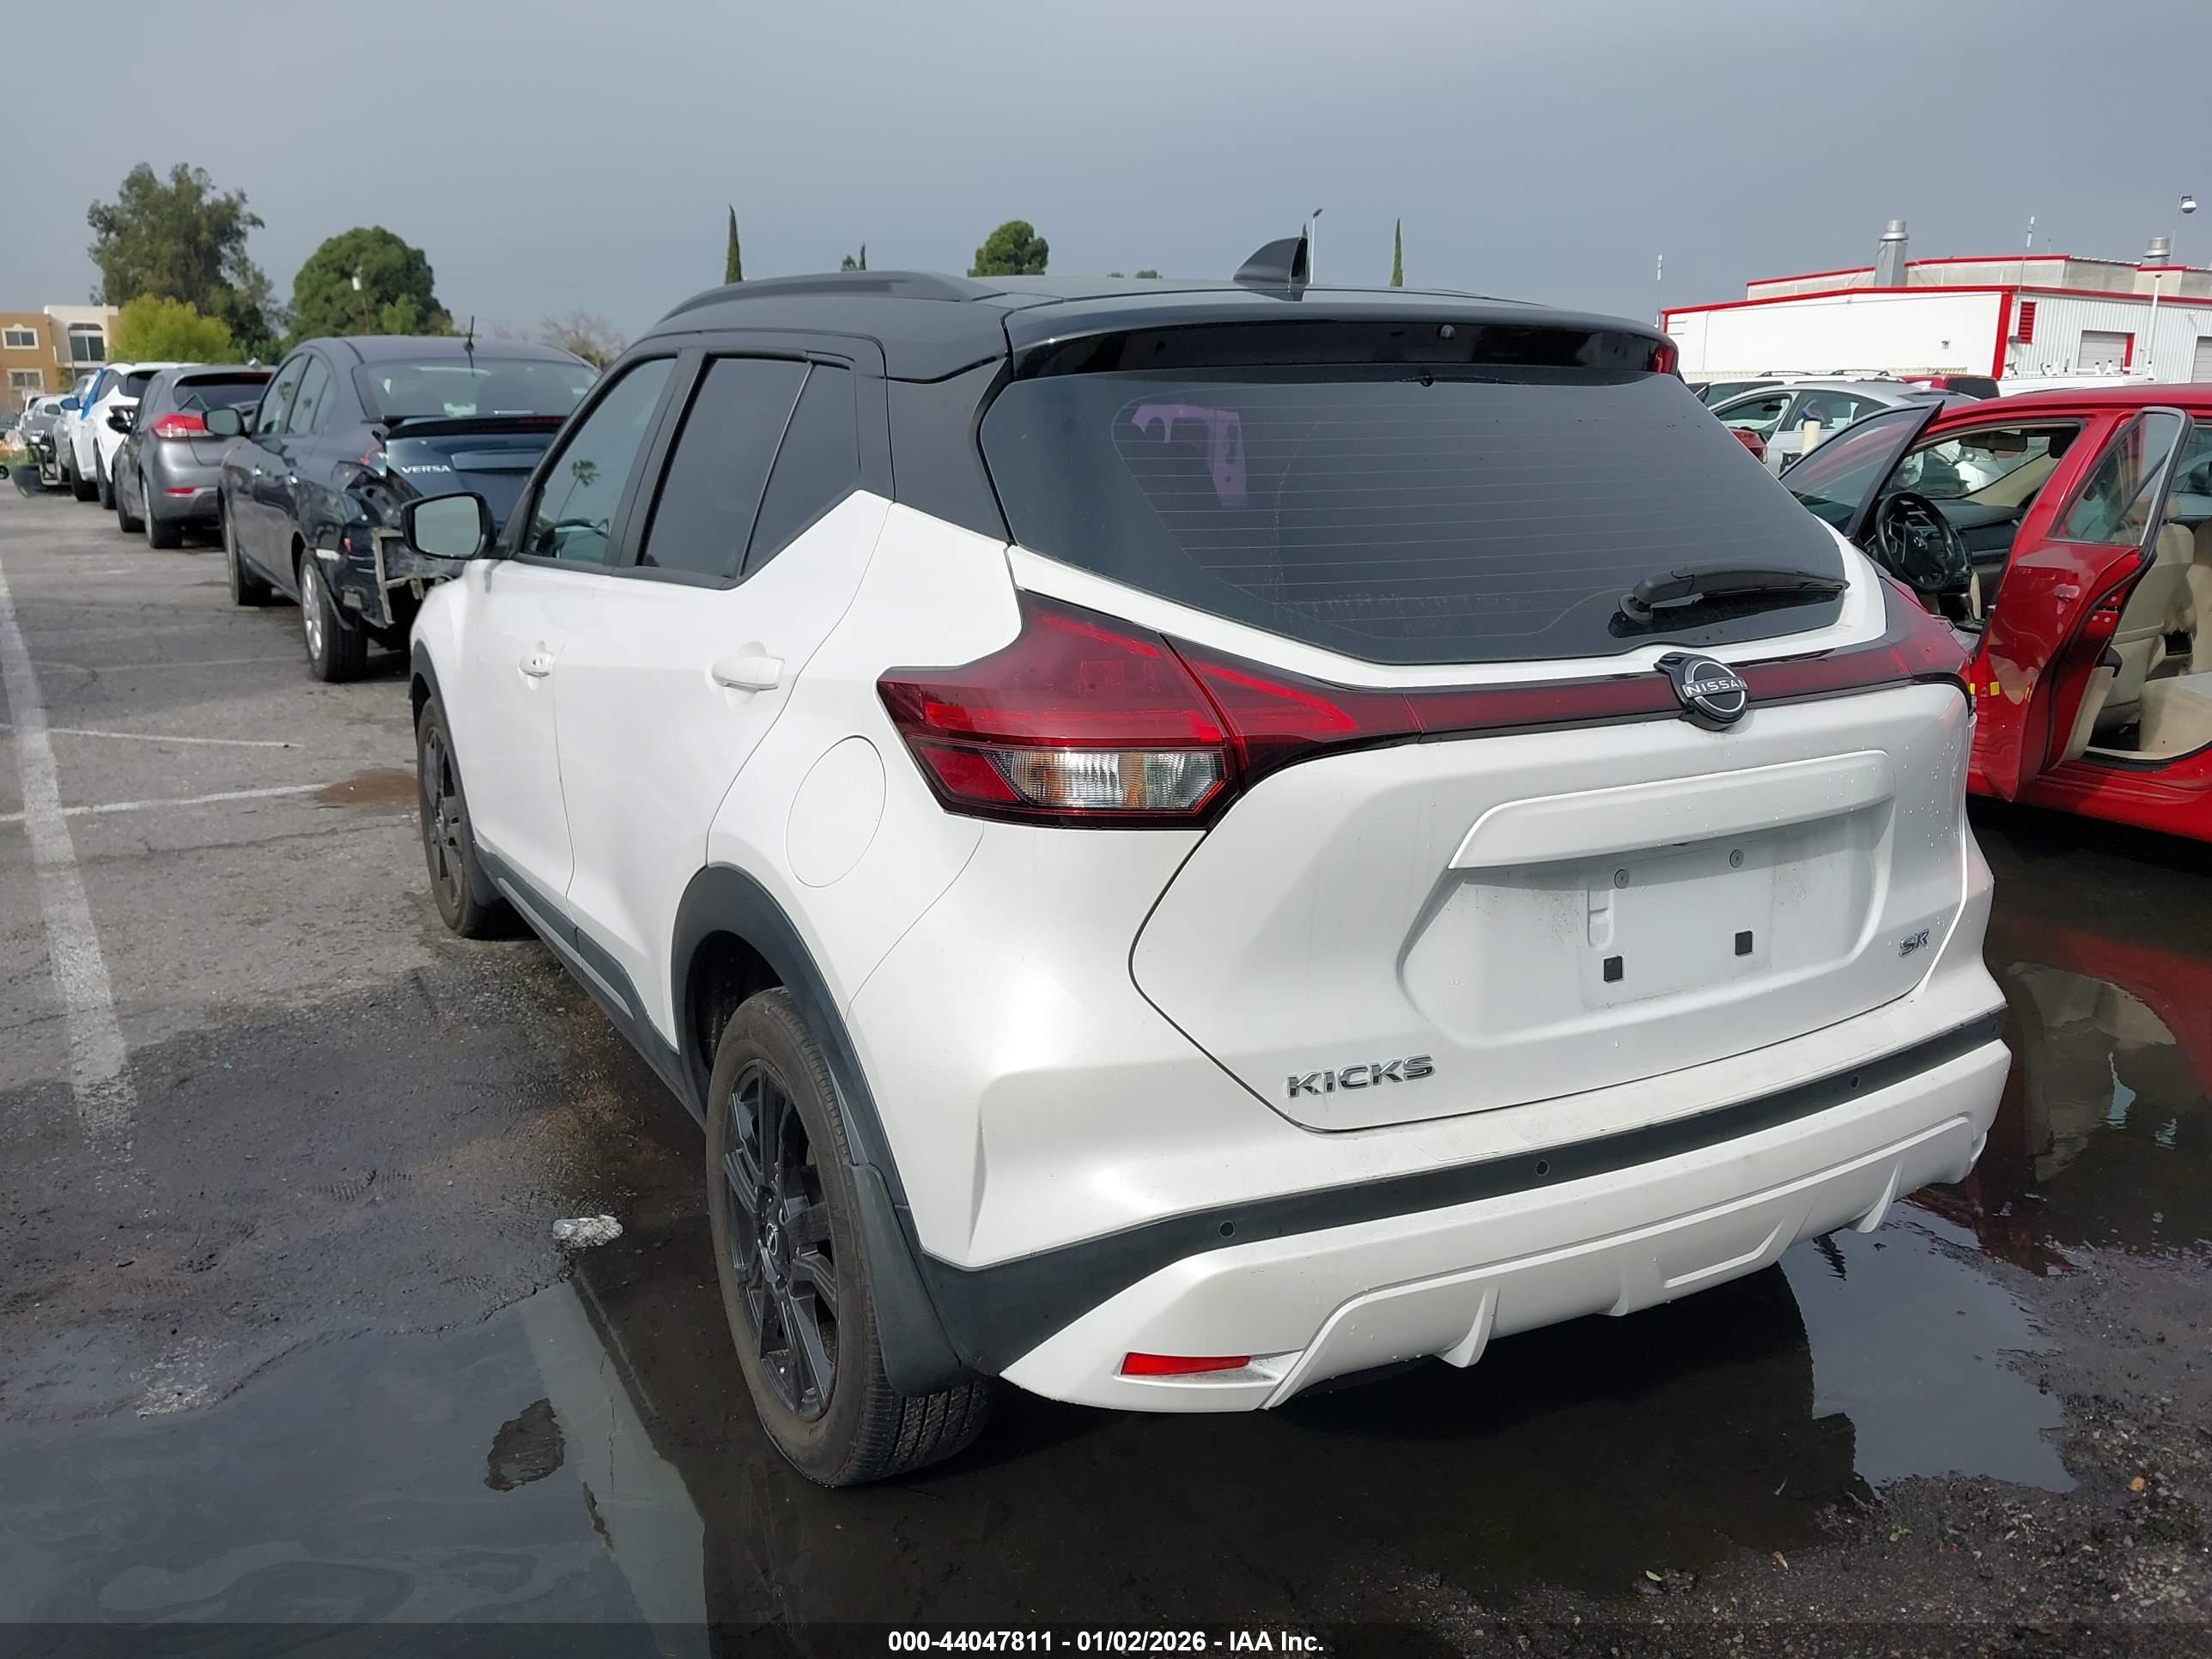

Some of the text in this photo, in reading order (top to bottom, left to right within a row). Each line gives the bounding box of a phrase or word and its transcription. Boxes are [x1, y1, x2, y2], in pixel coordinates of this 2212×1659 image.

[401, 465, 451, 474] VERSA
[1686, 679, 1747, 696] NISSAN
[1286, 1054, 1435, 1098] KICKS
